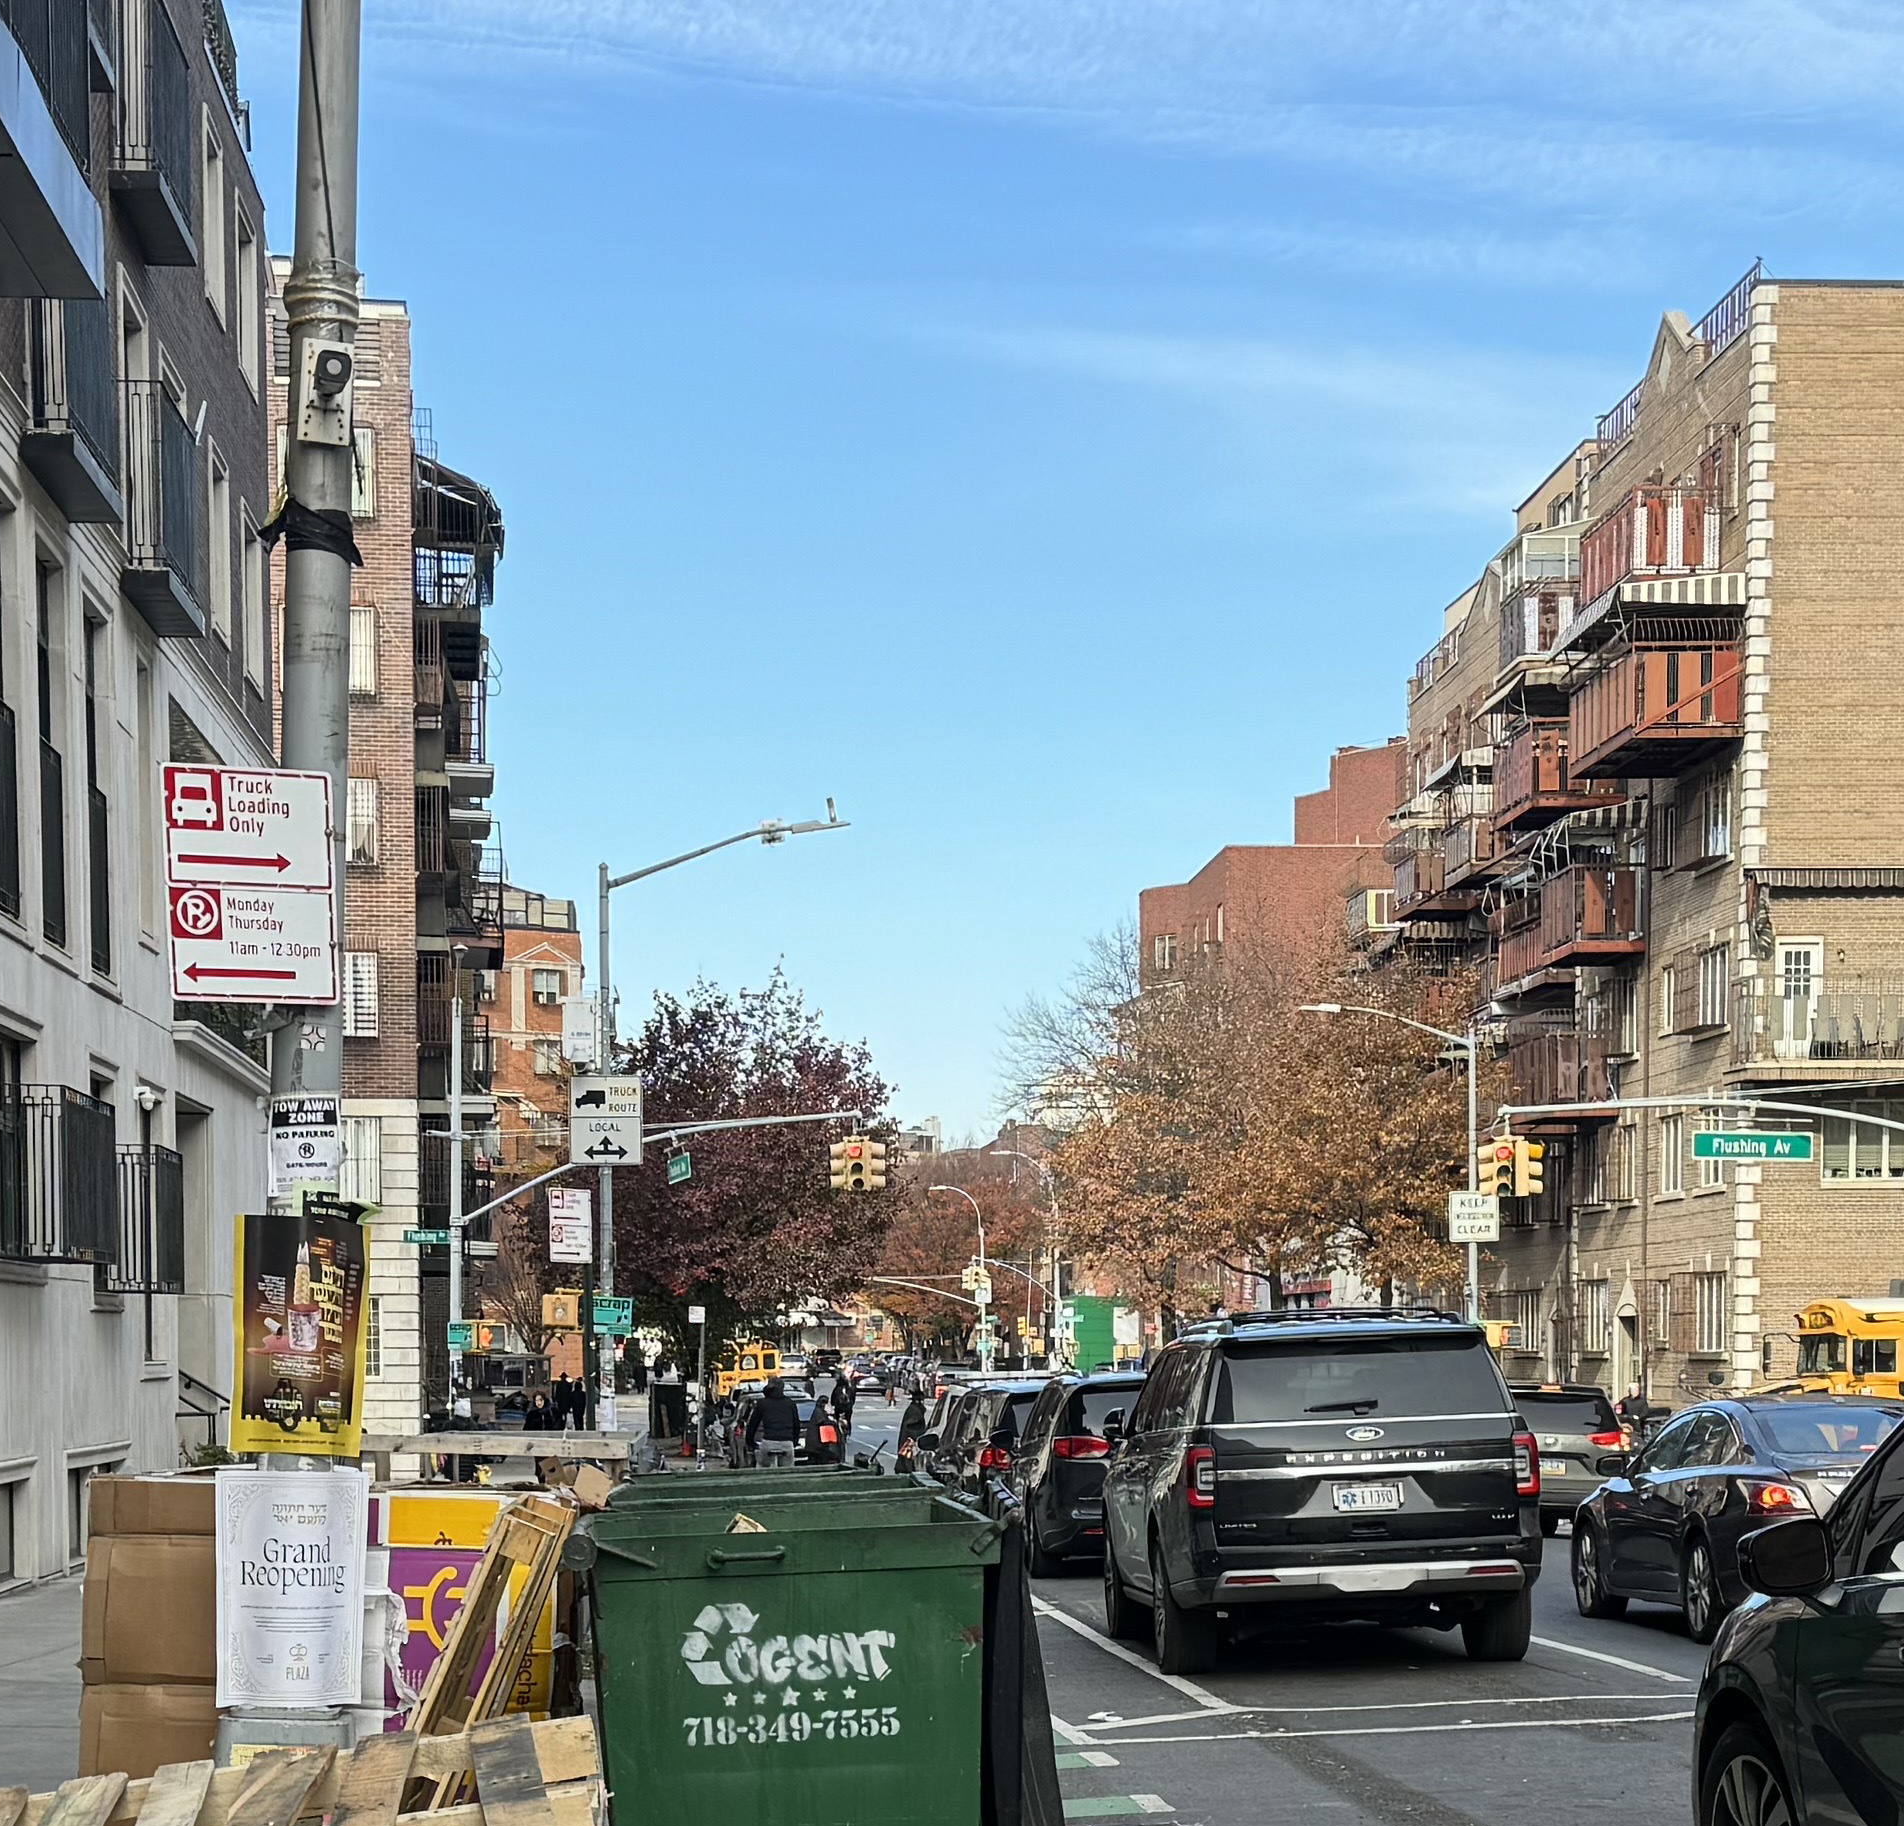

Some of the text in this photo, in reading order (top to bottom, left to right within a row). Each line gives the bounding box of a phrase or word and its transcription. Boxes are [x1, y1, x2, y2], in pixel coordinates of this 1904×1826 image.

[228, 776, 273, 795] Truck
[228, 797, 290, 818] Loading
[229, 816, 264, 837] Only
[227, 898, 274, 913] Monday
[228, 916, 284, 933] Thursday
[229, 942, 258, 955] 11am
[609, 1086, 638, 1096] TRUCK
[274, 1099, 334, 1113] TOW AWAY
[608, 1104, 637, 1113] ROUTE
[288, 1112, 324, 1124] ZONE
[589, 1122, 621, 1132] LOCAL
[1712, 1138, 1791, 1157] Flushing Av
[263, 1536, 330, 1563] Grand
[241, 1561, 346, 1595] Reopening
[682, 1706, 901, 1747] 718-349-7555
